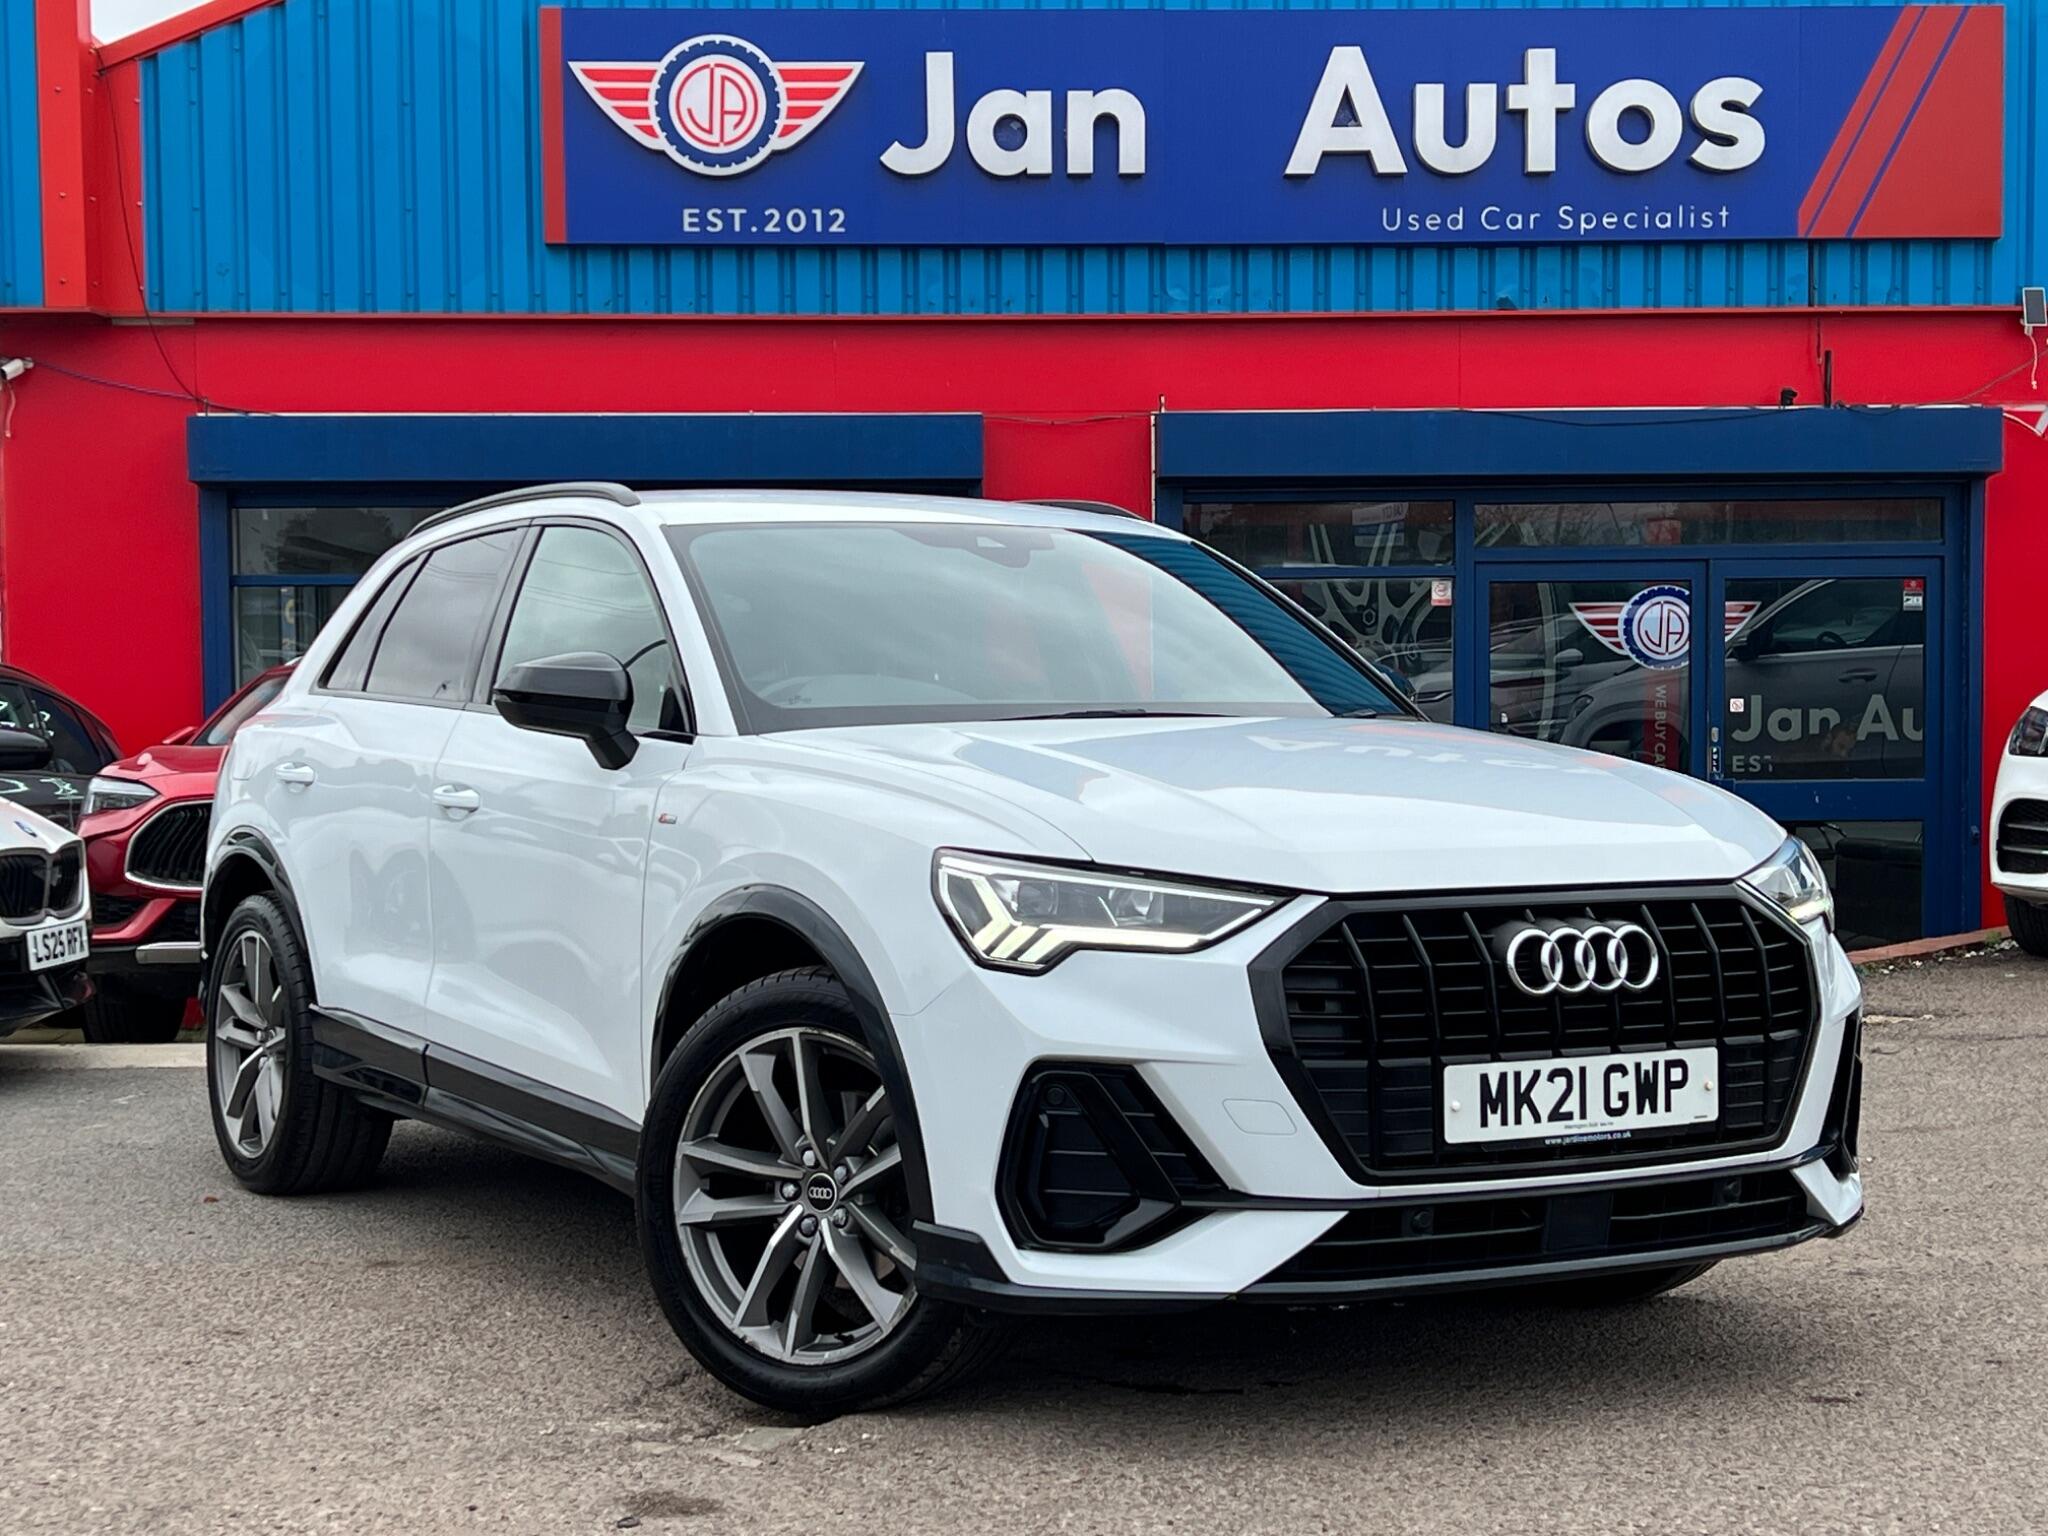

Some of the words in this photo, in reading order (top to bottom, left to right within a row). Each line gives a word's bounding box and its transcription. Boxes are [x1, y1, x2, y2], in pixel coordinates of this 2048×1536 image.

[881, 51, 1147, 176] Jan
[1284, 46, 1766, 177] Autos
[682, 208, 846, 233] EST.2012
[1382, 207, 1463, 231] Used
[1480, 206, 1541, 230] Car
[1558, 205, 1730, 235] Specialist
[1655, 685, 1667, 707] WE
[1655, 711, 1667, 740] BUY
[1731, 695, 1840, 742] Jan
[1654, 743, 1666, 768] CA
[33, 931, 65, 962] LS25
[1479, 1066, 1587, 1128] MK21
[1603, 1058, 1689, 1117] GWP
